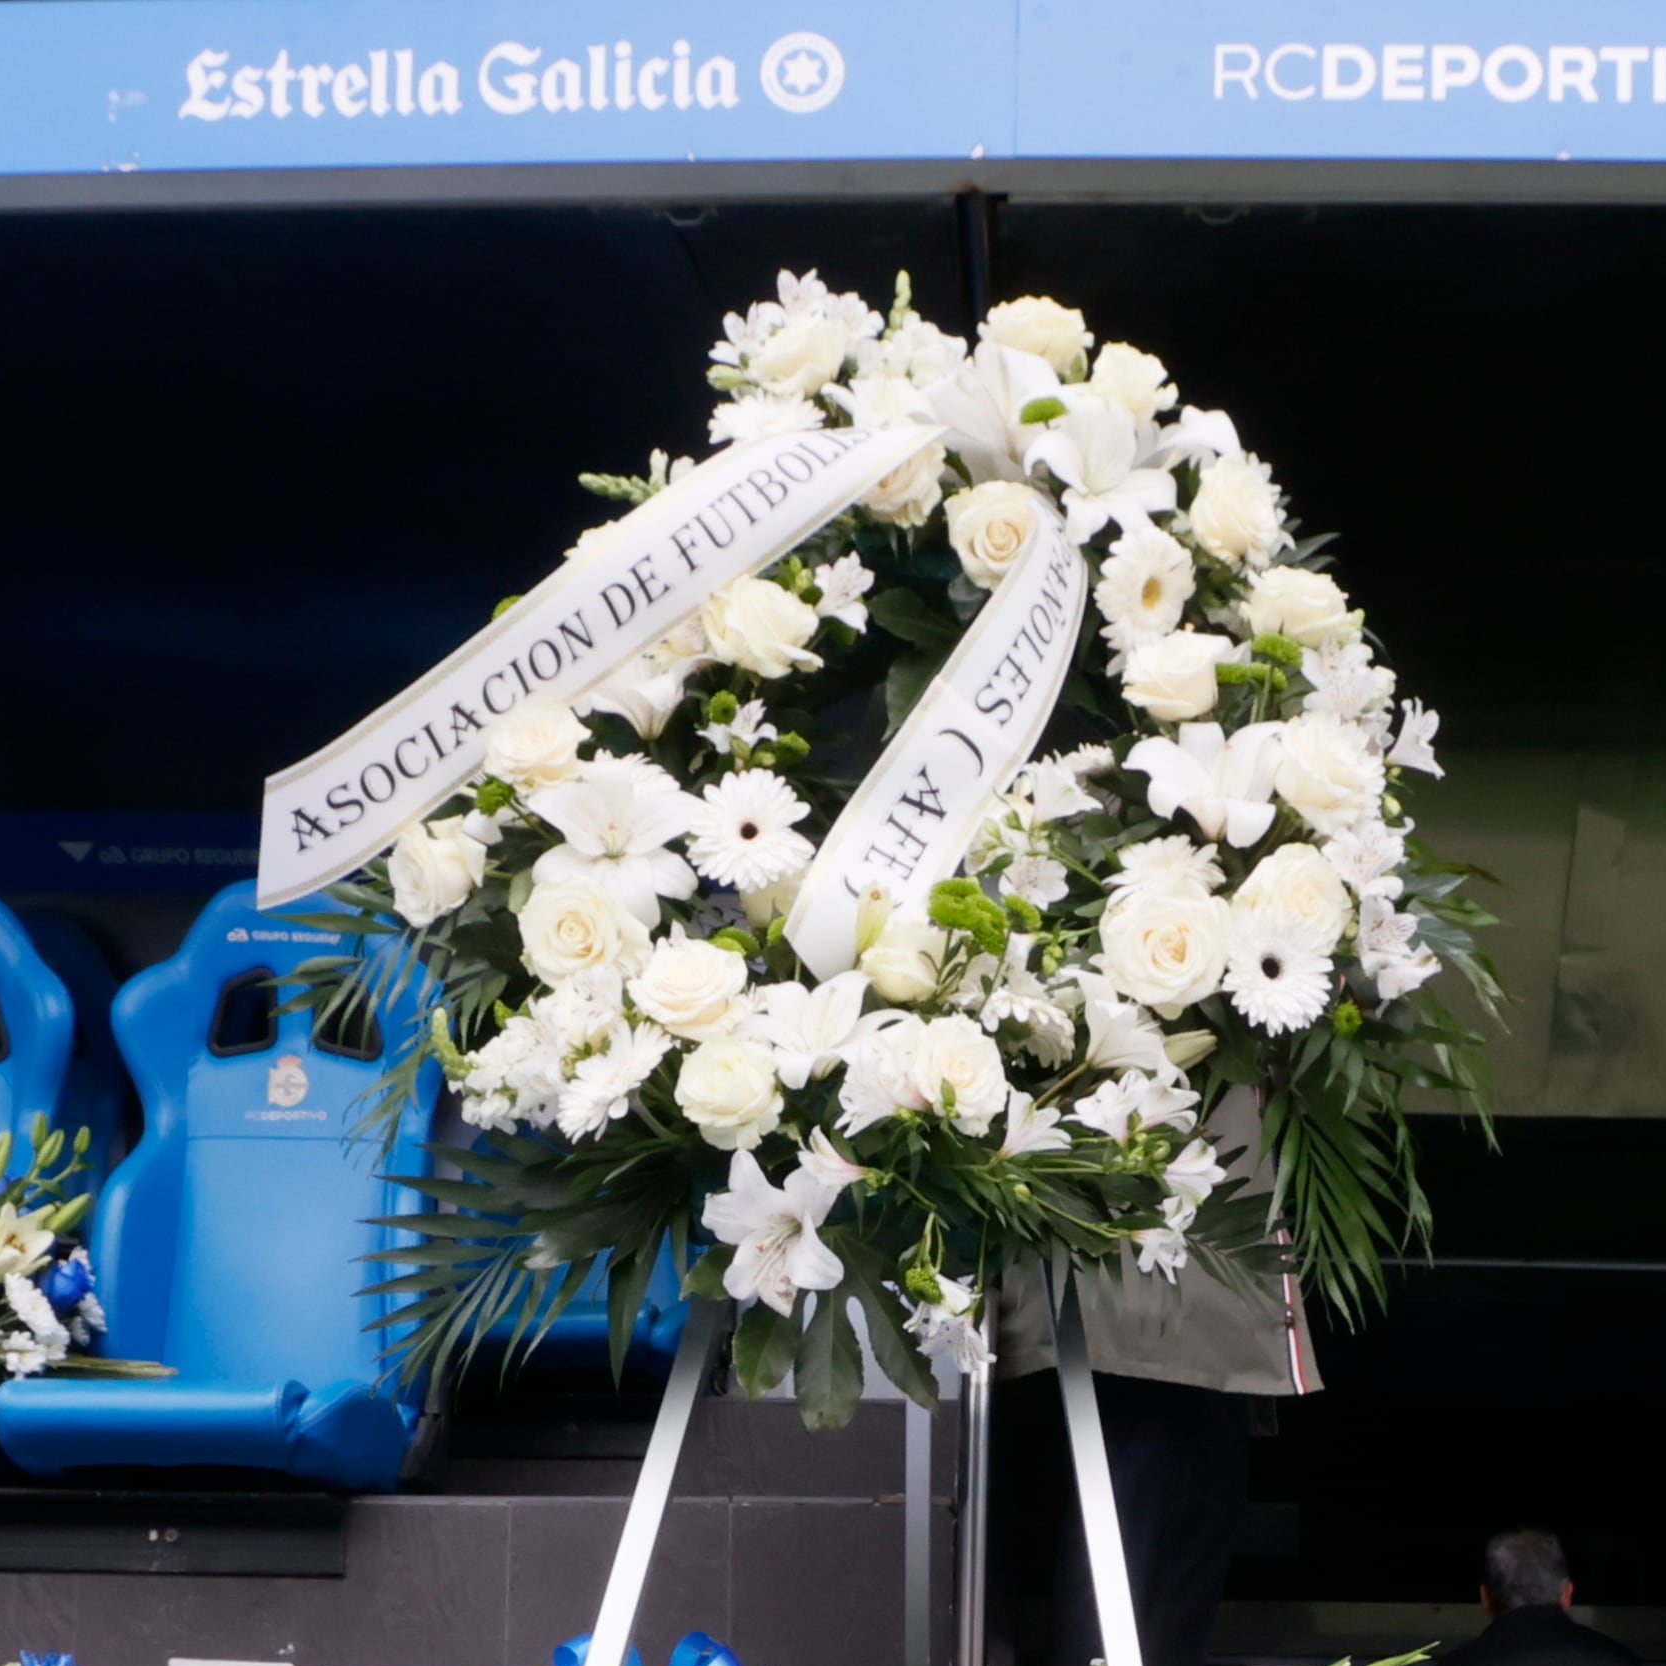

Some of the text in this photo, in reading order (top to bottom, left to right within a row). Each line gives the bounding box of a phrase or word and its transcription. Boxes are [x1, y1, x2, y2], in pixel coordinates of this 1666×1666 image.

[178, 39, 740, 121] Estrella Galicia
[288, 617, 601, 856] ASOCIACION
[610, 556, 671, 631] DE
